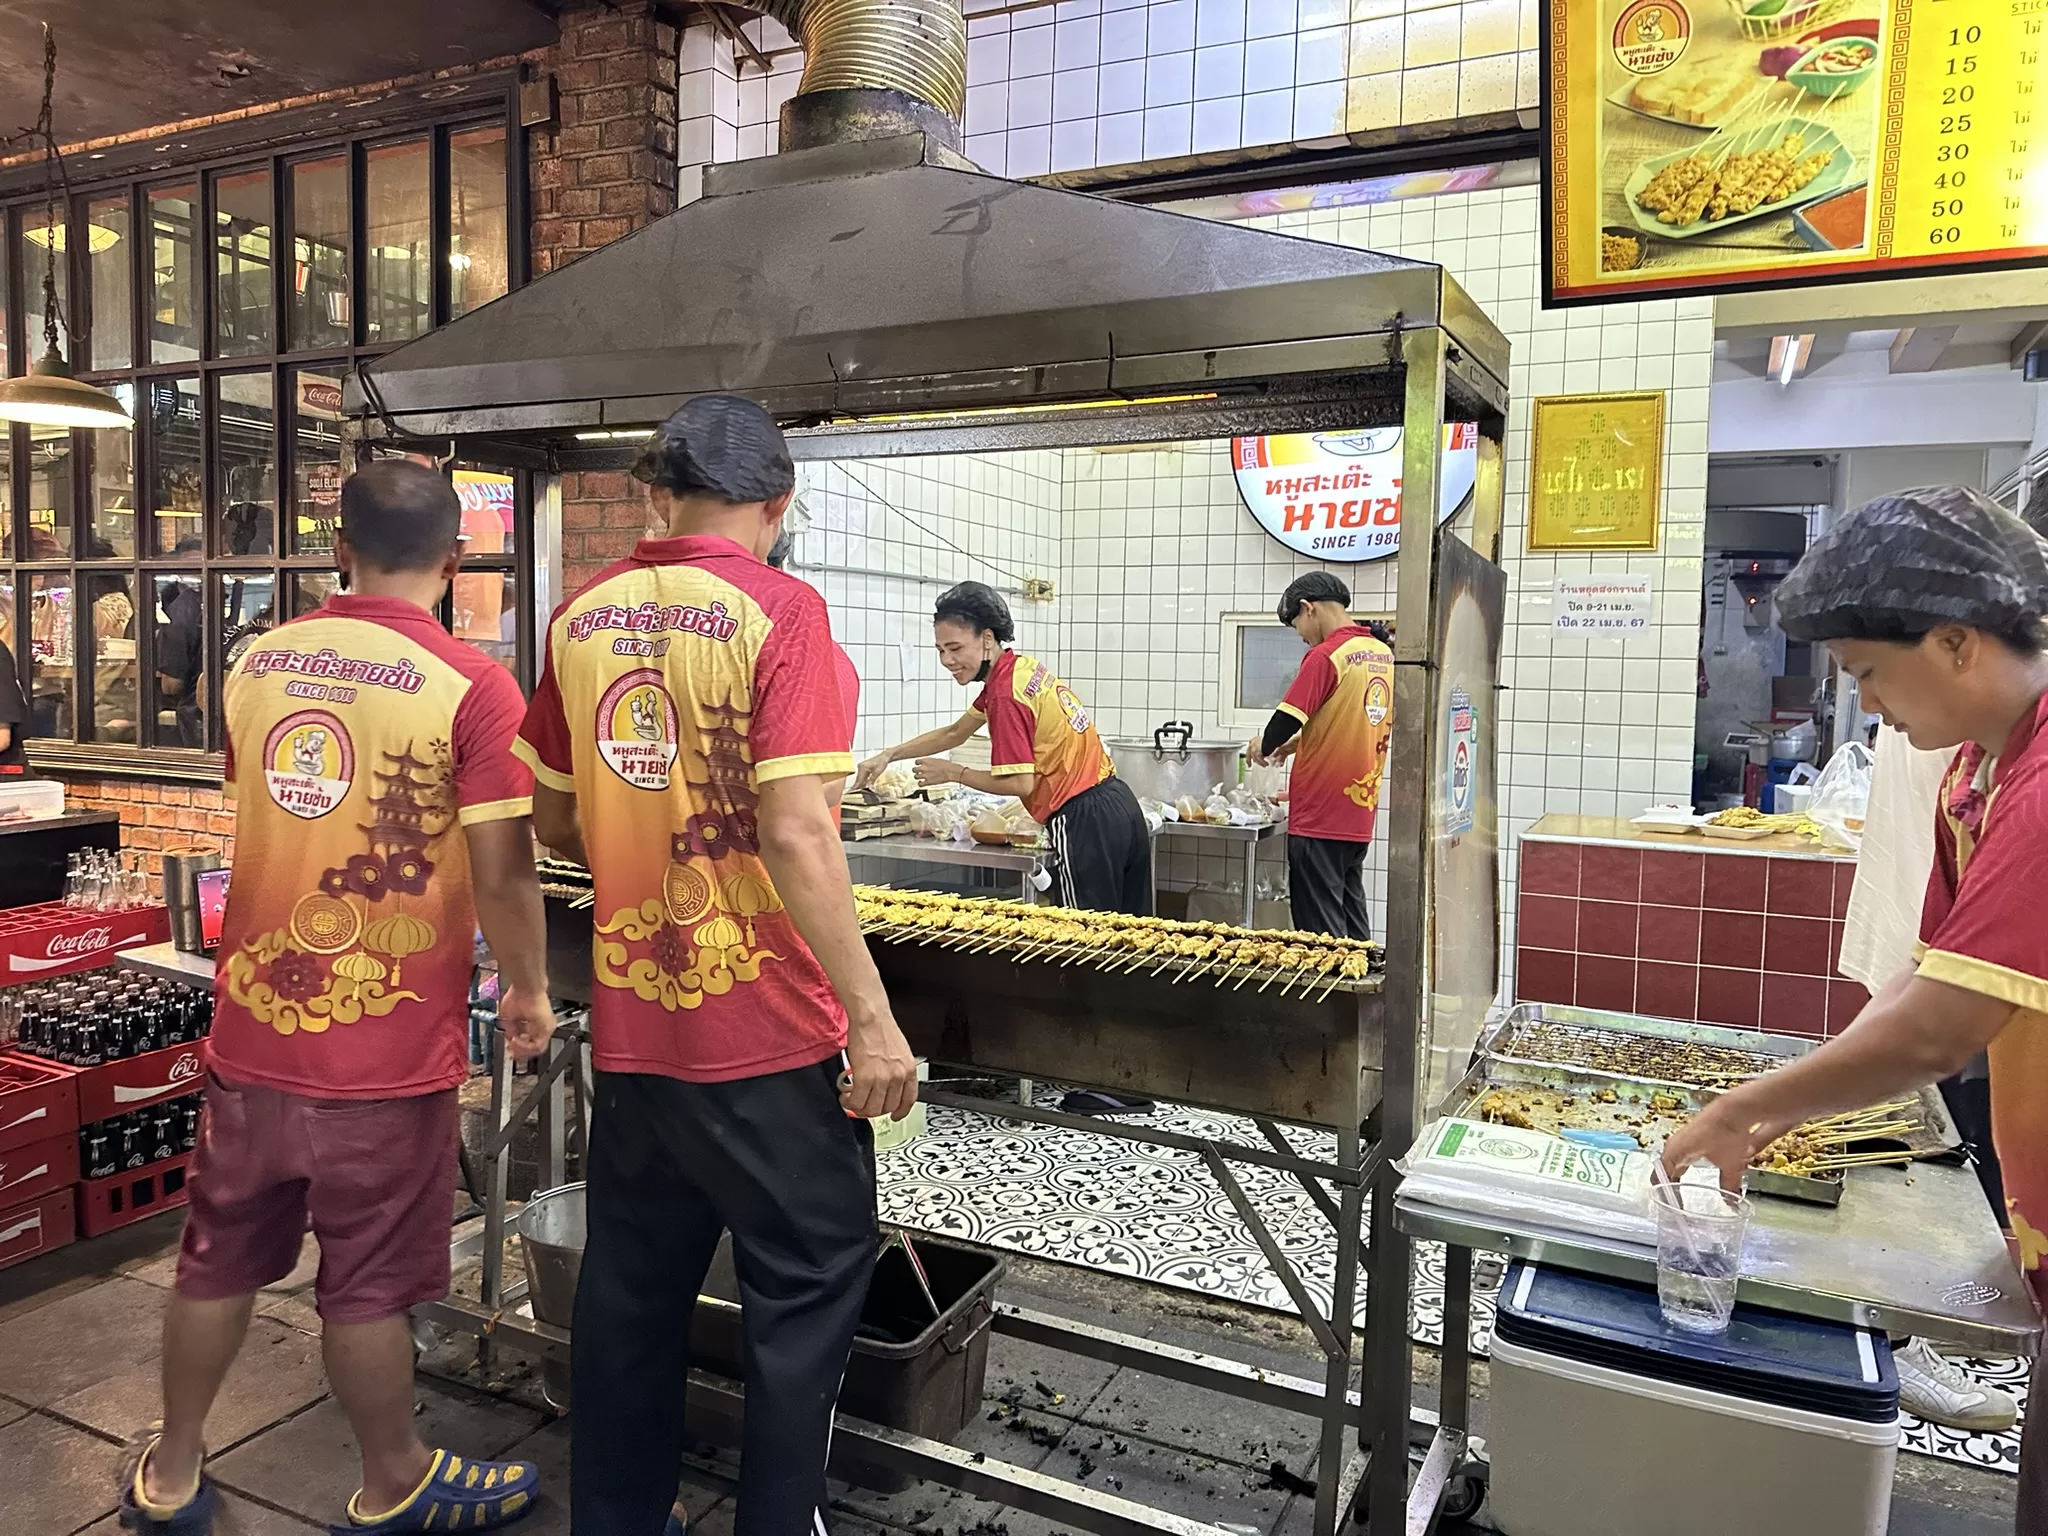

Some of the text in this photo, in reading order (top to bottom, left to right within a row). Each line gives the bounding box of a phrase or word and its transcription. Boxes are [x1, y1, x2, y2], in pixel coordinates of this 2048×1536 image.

[1948, 25, 1981, 46] 10
[1945, 55, 1978, 76] 15
[1942, 85, 1974, 105] 20
[1940, 114, 1972, 134] 25
[1937, 143, 1969, 162] 30
[1933, 171, 1966, 189] 40
[1931, 199, 1963, 218] 50
[1929, 227, 1961, 245] 60
[1265, 464, 1372, 501] หมูสะเต๊ะ
[1283, 478, 1402, 533] นายซ้
[1311, 532, 1400, 550] SINCE 1980
[1559, 583, 1646, 597] ร้านหยุดสงกรานต์
[1567, 600, 1635, 611] ปิด 9-21 เม.ย.
[1557, 615, 1645, 627] เปิด 22 เม.ย. 67
[286, 680, 327, 699] SINCE
[621, 753, 668, 775] นายซ้
[46, 925, 113, 957] Coca-Cola
